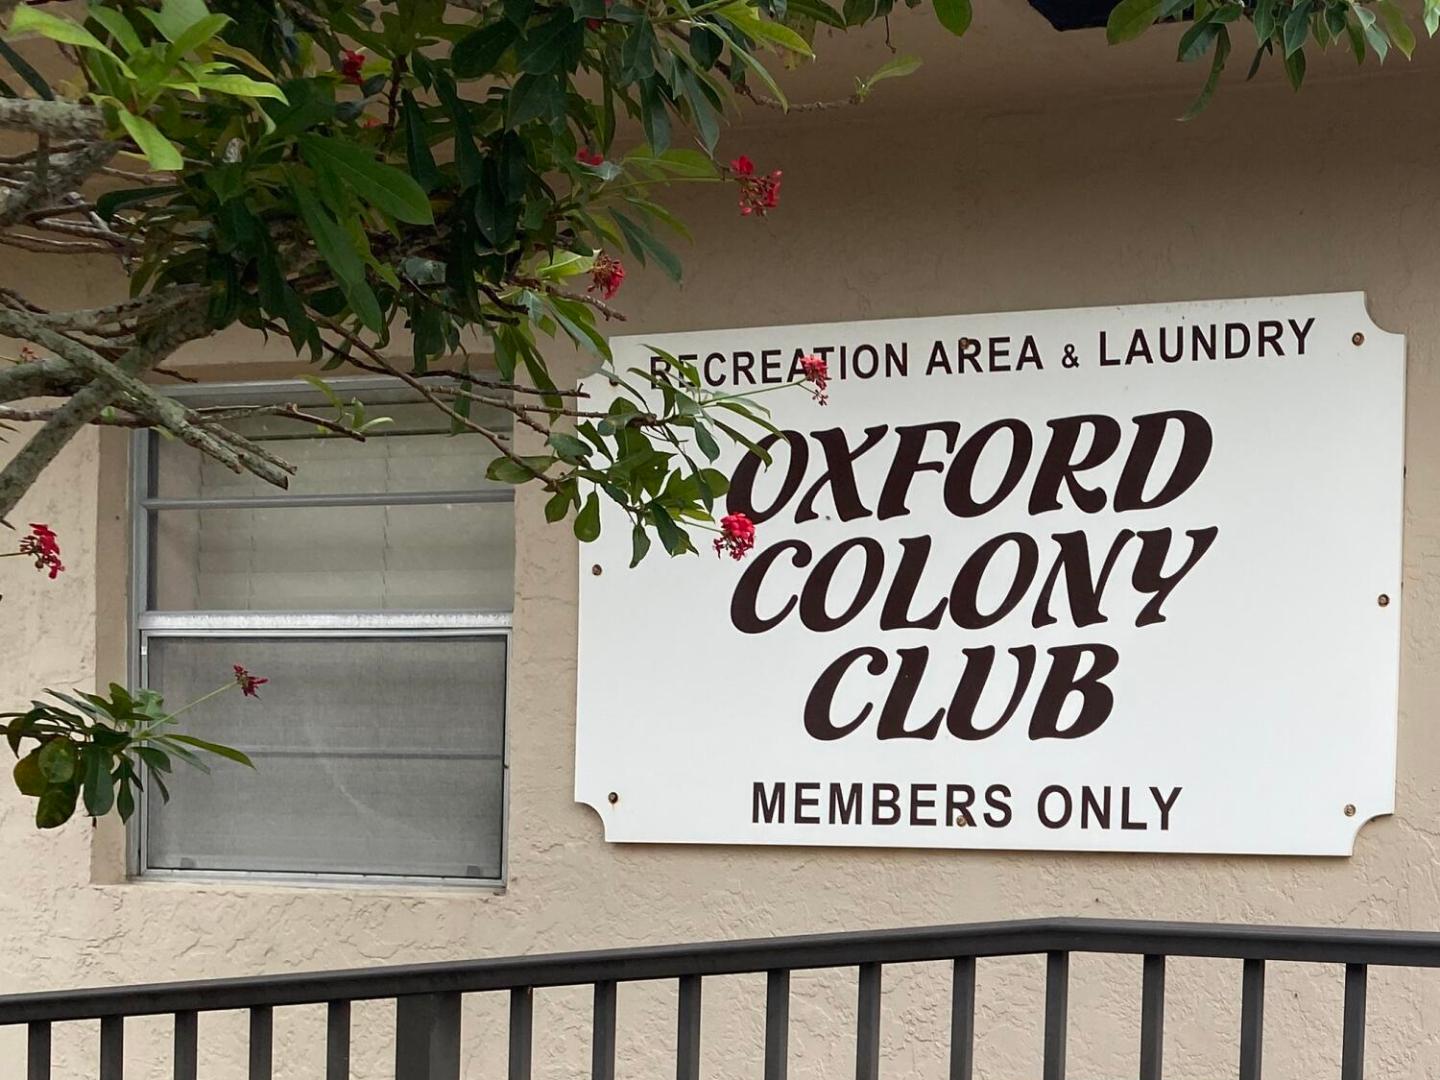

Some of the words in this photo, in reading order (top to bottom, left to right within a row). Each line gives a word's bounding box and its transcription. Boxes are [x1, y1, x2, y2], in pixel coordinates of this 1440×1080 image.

[925, 334, 1044, 376] AREA
[1061, 343, 1080, 369] &
[1099, 317, 1316, 367] LAUNDRY
[726, 409, 1213, 525] OXFORD
[730, 525, 1219, 635] COLONY
[803, 643, 1119, 741] CLUB
[752, 781, 1012, 828] MEMBERS
[1037, 784, 1183, 831] ONLY
